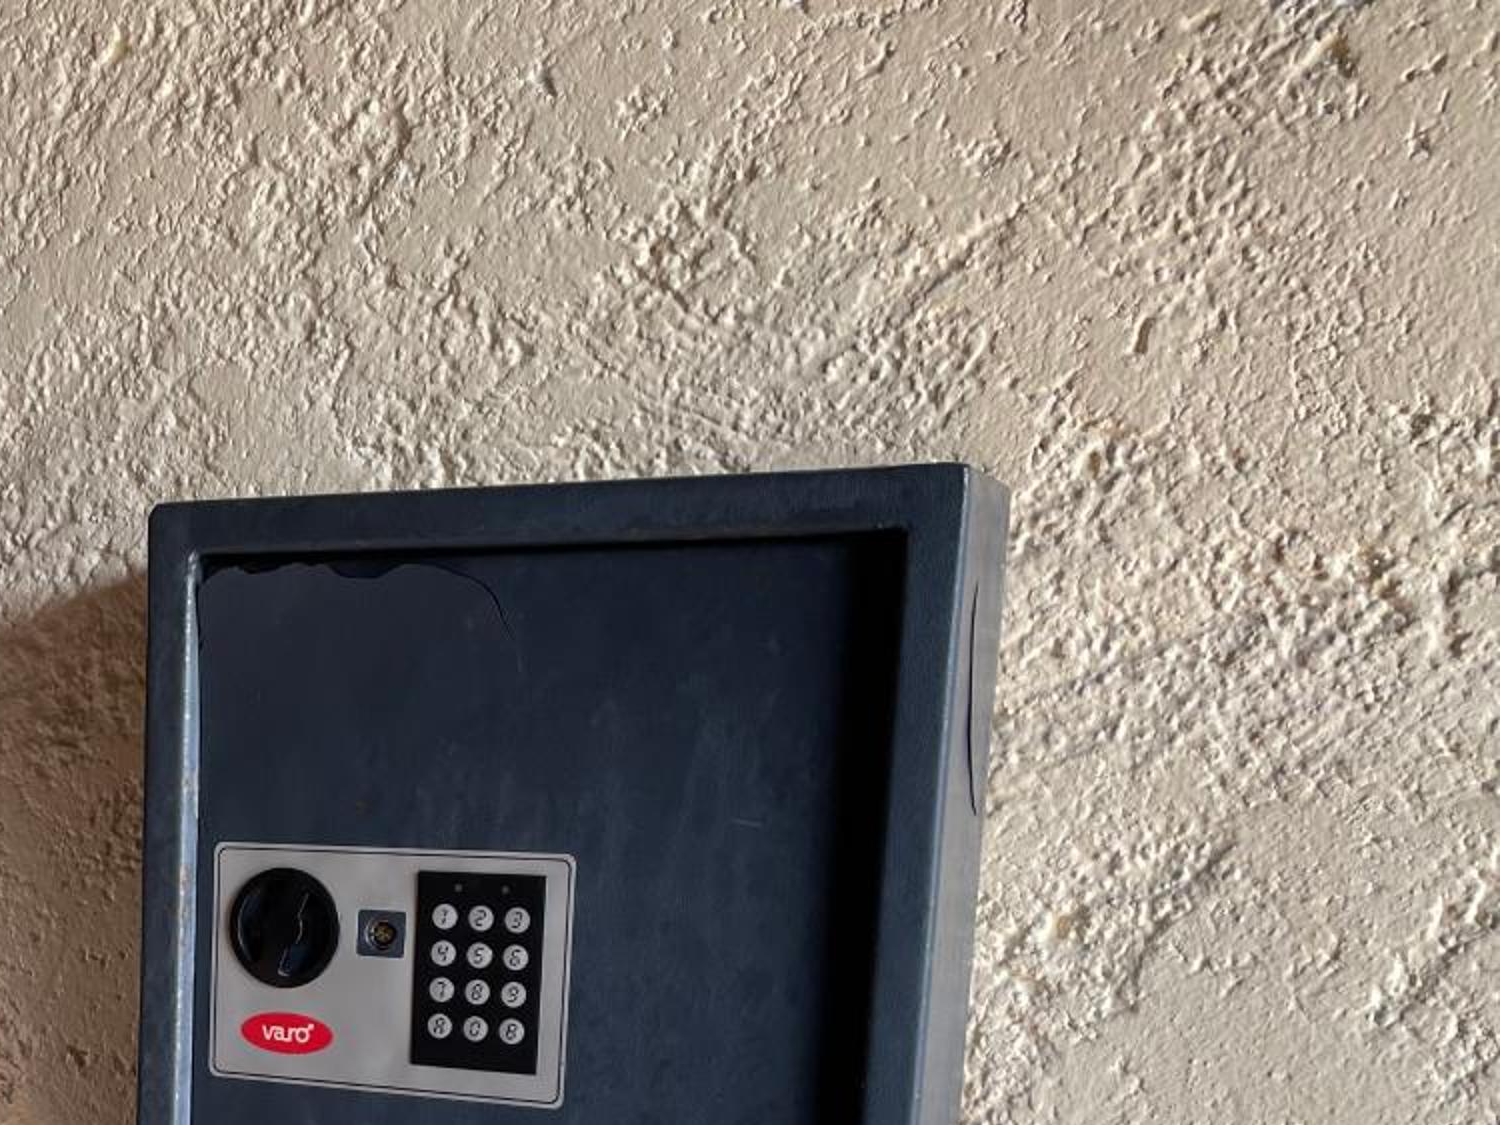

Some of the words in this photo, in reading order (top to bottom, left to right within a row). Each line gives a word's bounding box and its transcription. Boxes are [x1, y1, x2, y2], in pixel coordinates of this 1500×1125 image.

[440, 908, 448, 925] 1
[475, 909, 487, 927] 2
[512, 911, 523, 929] 3
[437, 945, 449, 962] 4
[473, 947, 485, 964] 5
[509, 949, 521, 966] 6
[436, 981, 446, 998] 7
[471, 983, 483, 1001] 8
[508, 986, 519, 1003] 9
[261, 1023, 315, 1044] varo
